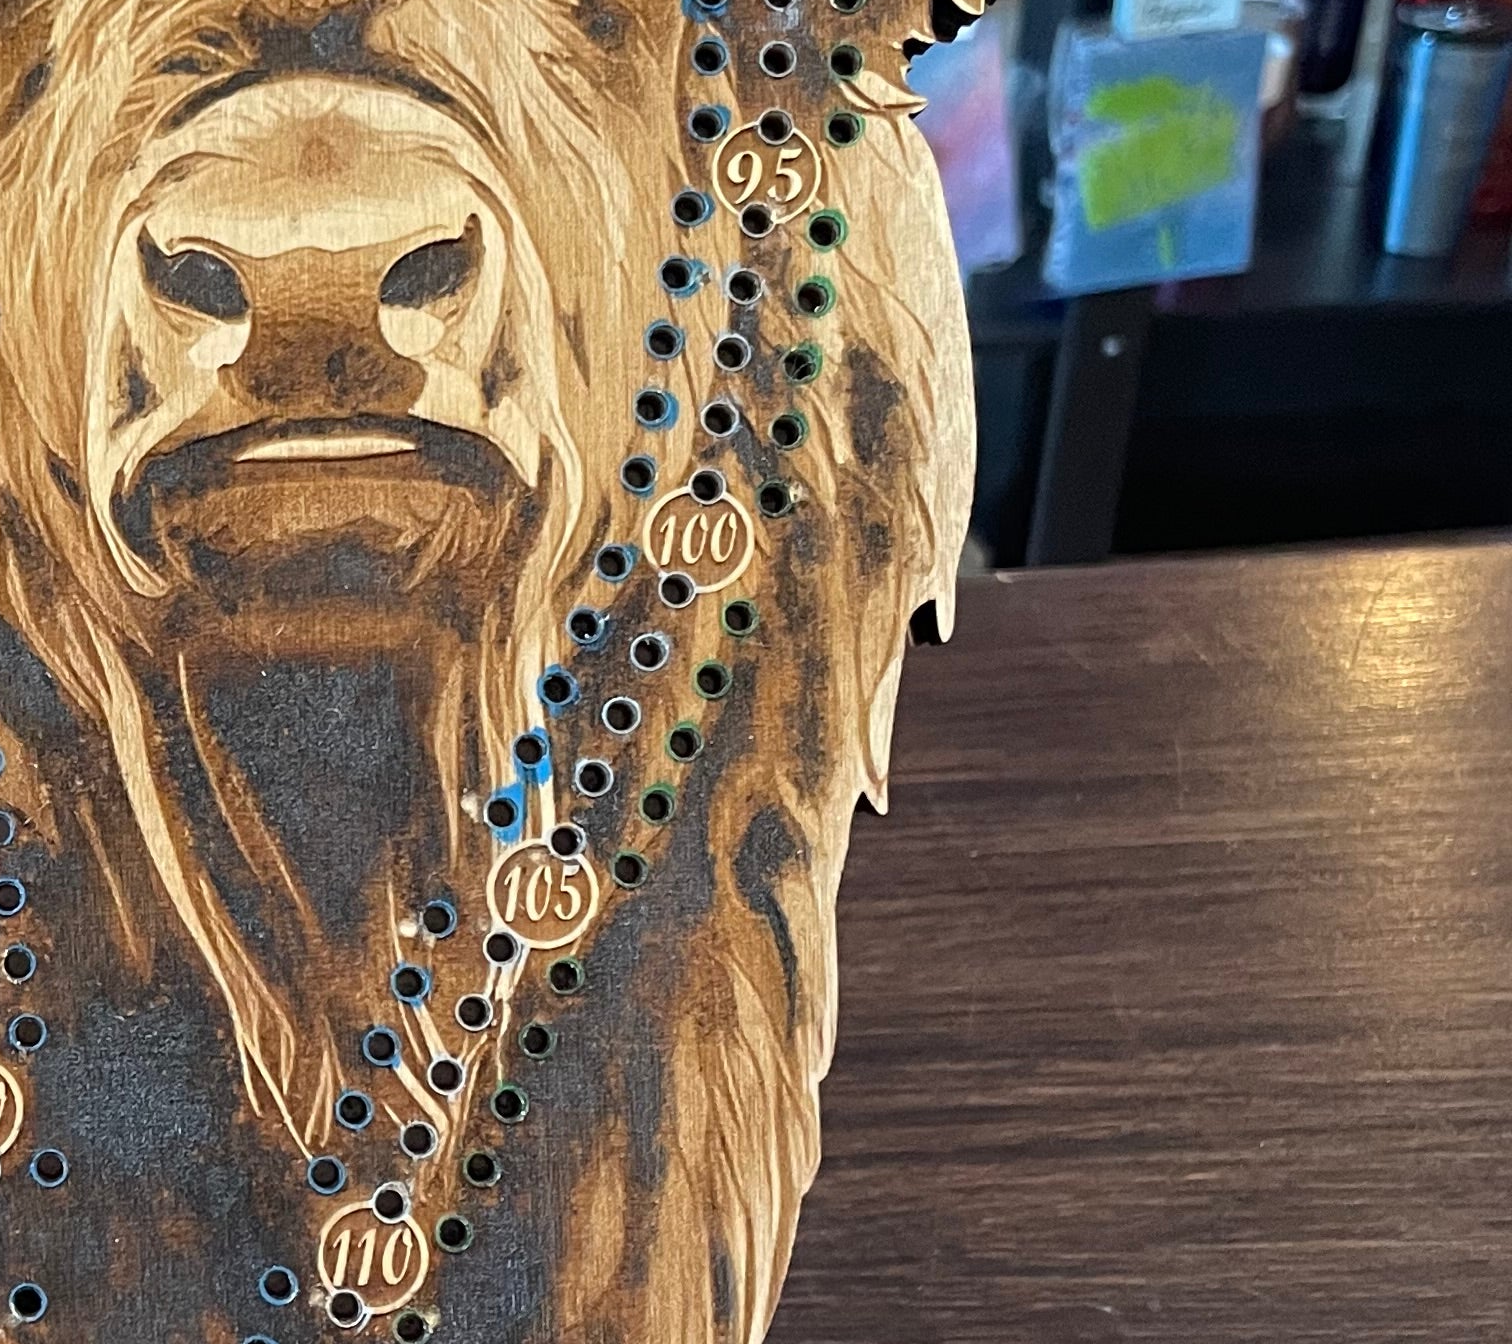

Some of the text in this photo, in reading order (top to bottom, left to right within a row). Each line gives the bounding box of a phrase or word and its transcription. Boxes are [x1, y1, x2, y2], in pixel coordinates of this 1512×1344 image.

[727, 147, 802, 205] 95
[660, 513, 737, 566] 100
[504, 865, 580, 922] 105
[333, 1228, 413, 1287] 110
